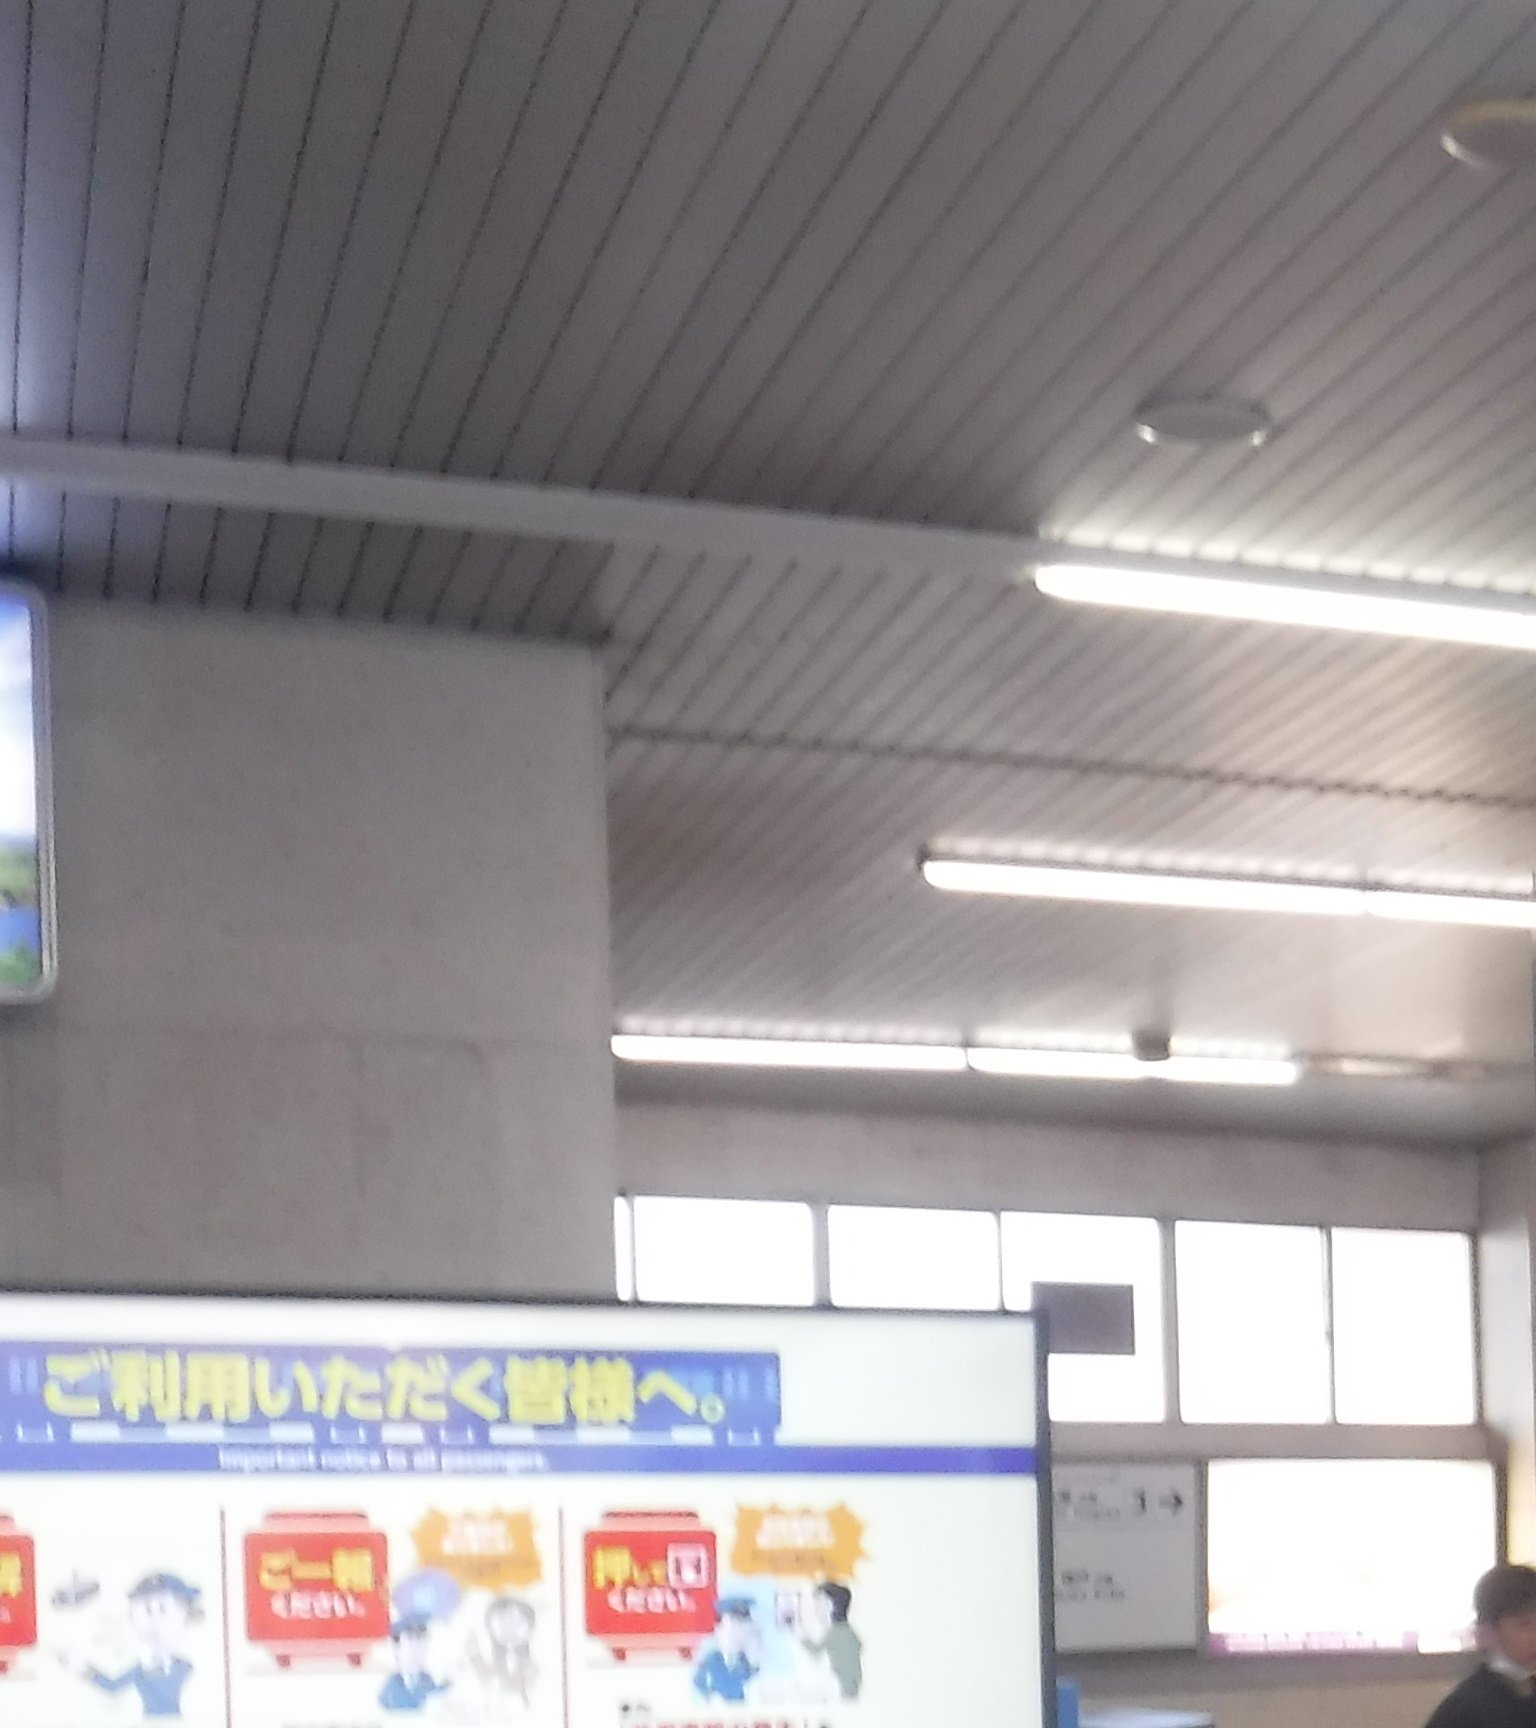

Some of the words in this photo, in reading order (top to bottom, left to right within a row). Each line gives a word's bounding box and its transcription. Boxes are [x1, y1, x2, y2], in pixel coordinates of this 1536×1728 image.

[44, 1349, 726, 1424] ご利用いただく皆様へ。
[257, 1547, 374, 1594] ご一報
